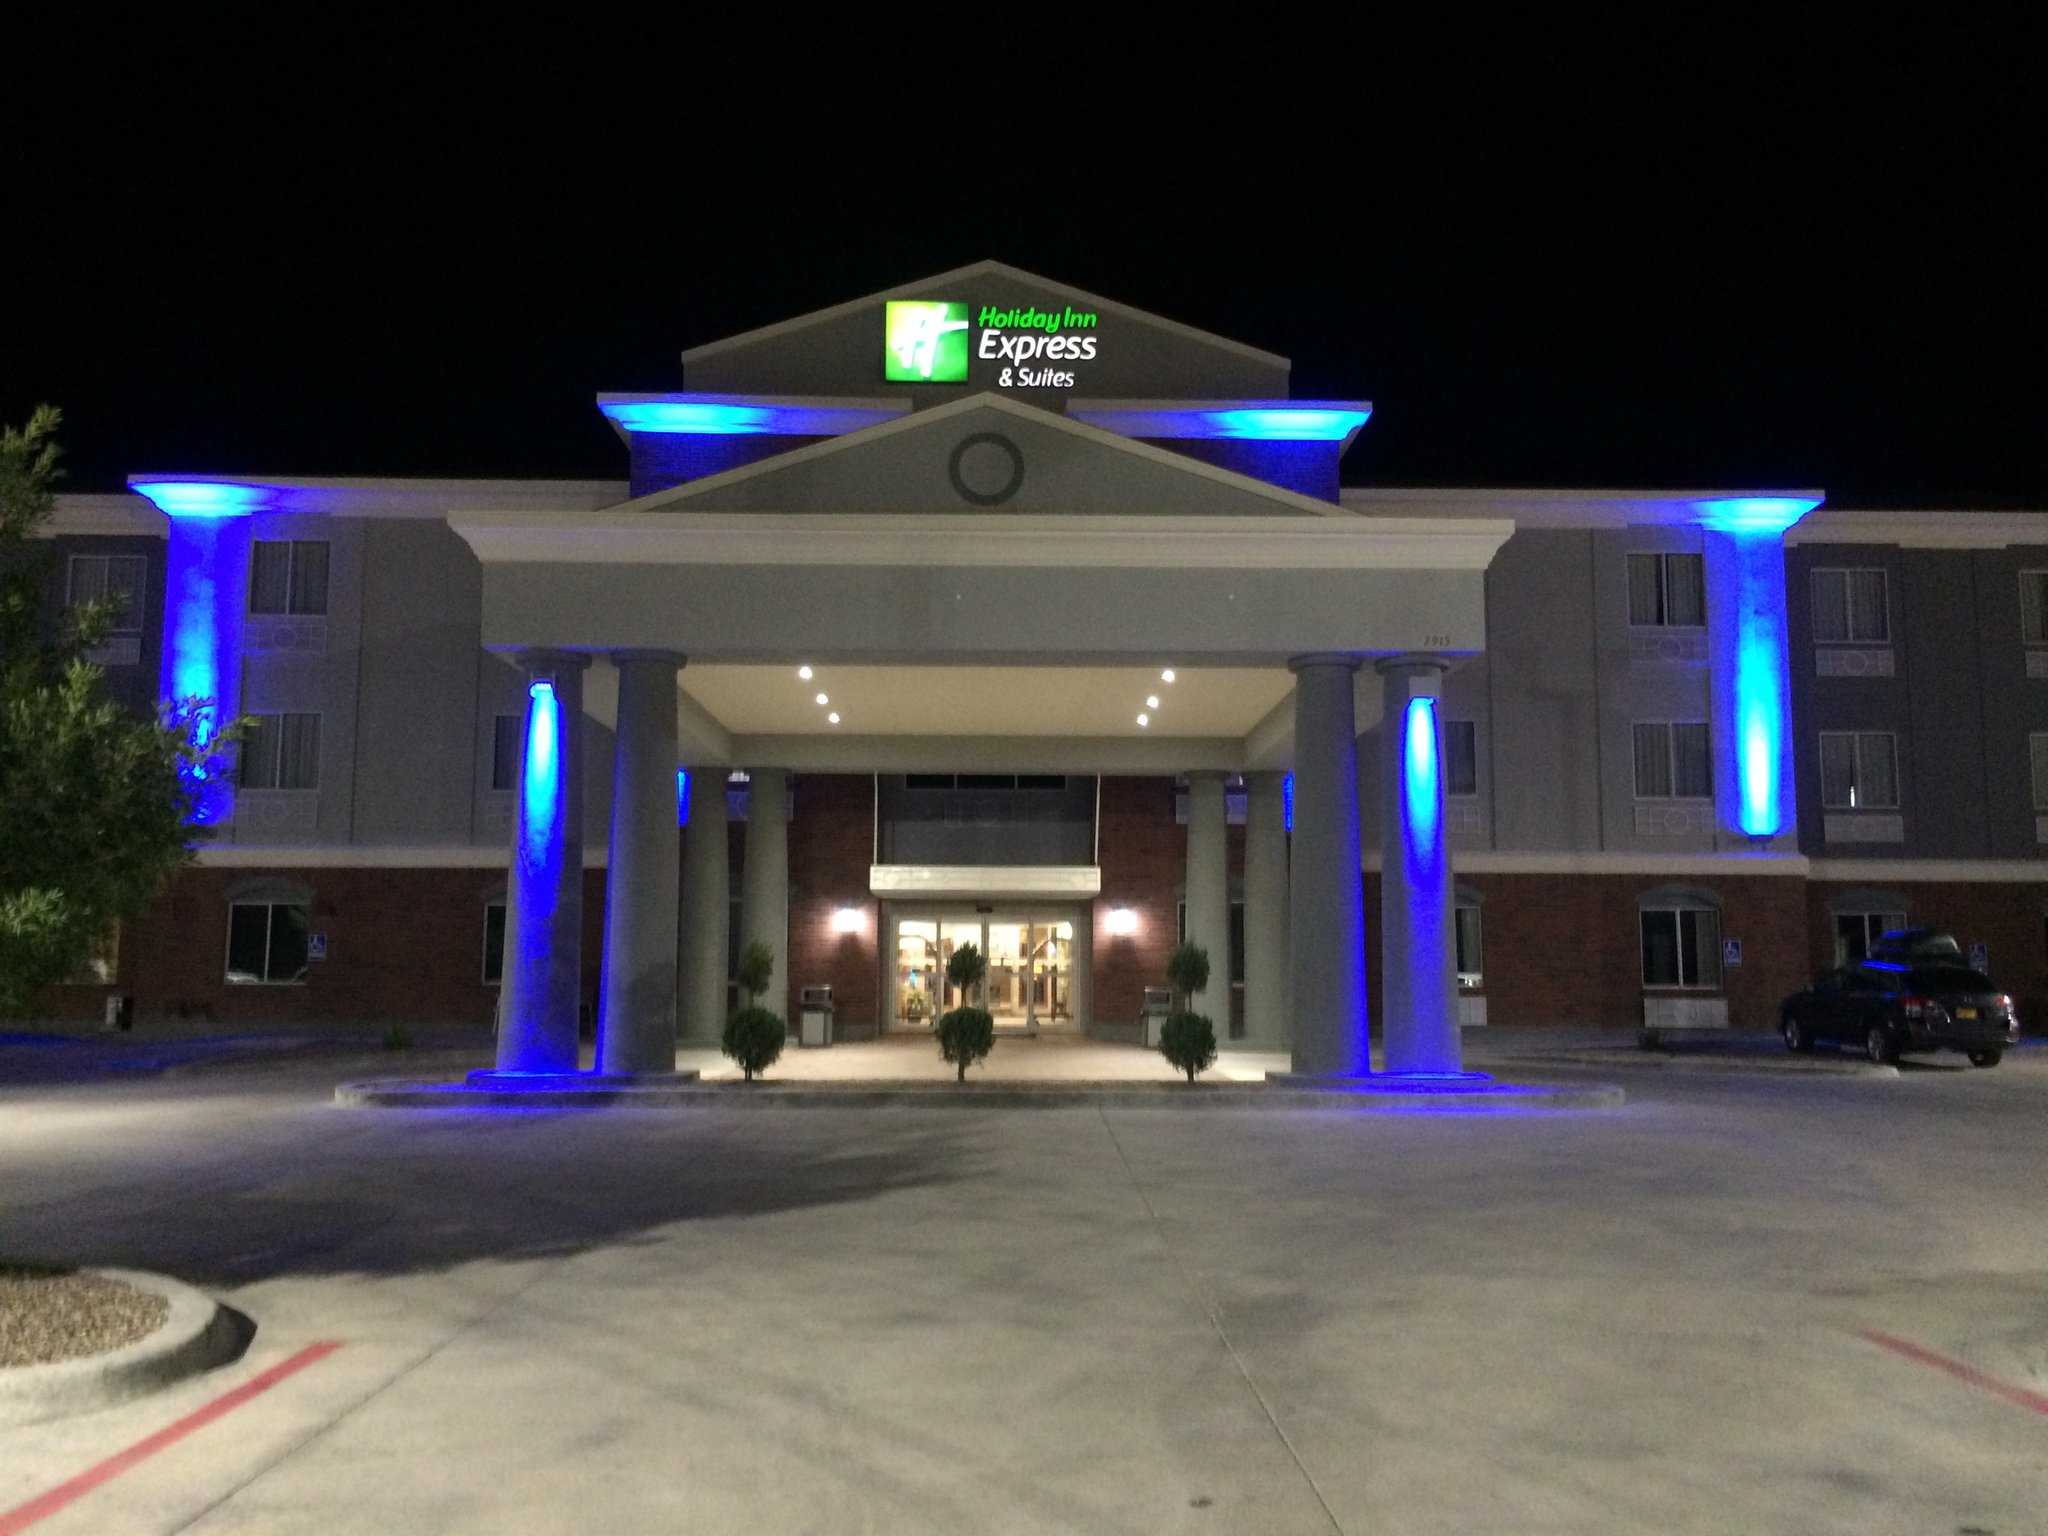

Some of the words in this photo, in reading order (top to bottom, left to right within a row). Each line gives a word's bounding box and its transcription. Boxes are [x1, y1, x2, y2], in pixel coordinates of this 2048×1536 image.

[978, 306, 1059, 333] Holiday
[1064, 306, 1097, 328] Inn
[978, 329, 1097, 366] Express
[998, 367, 1013, 388] &
[1017, 367, 1074, 388] Suites
